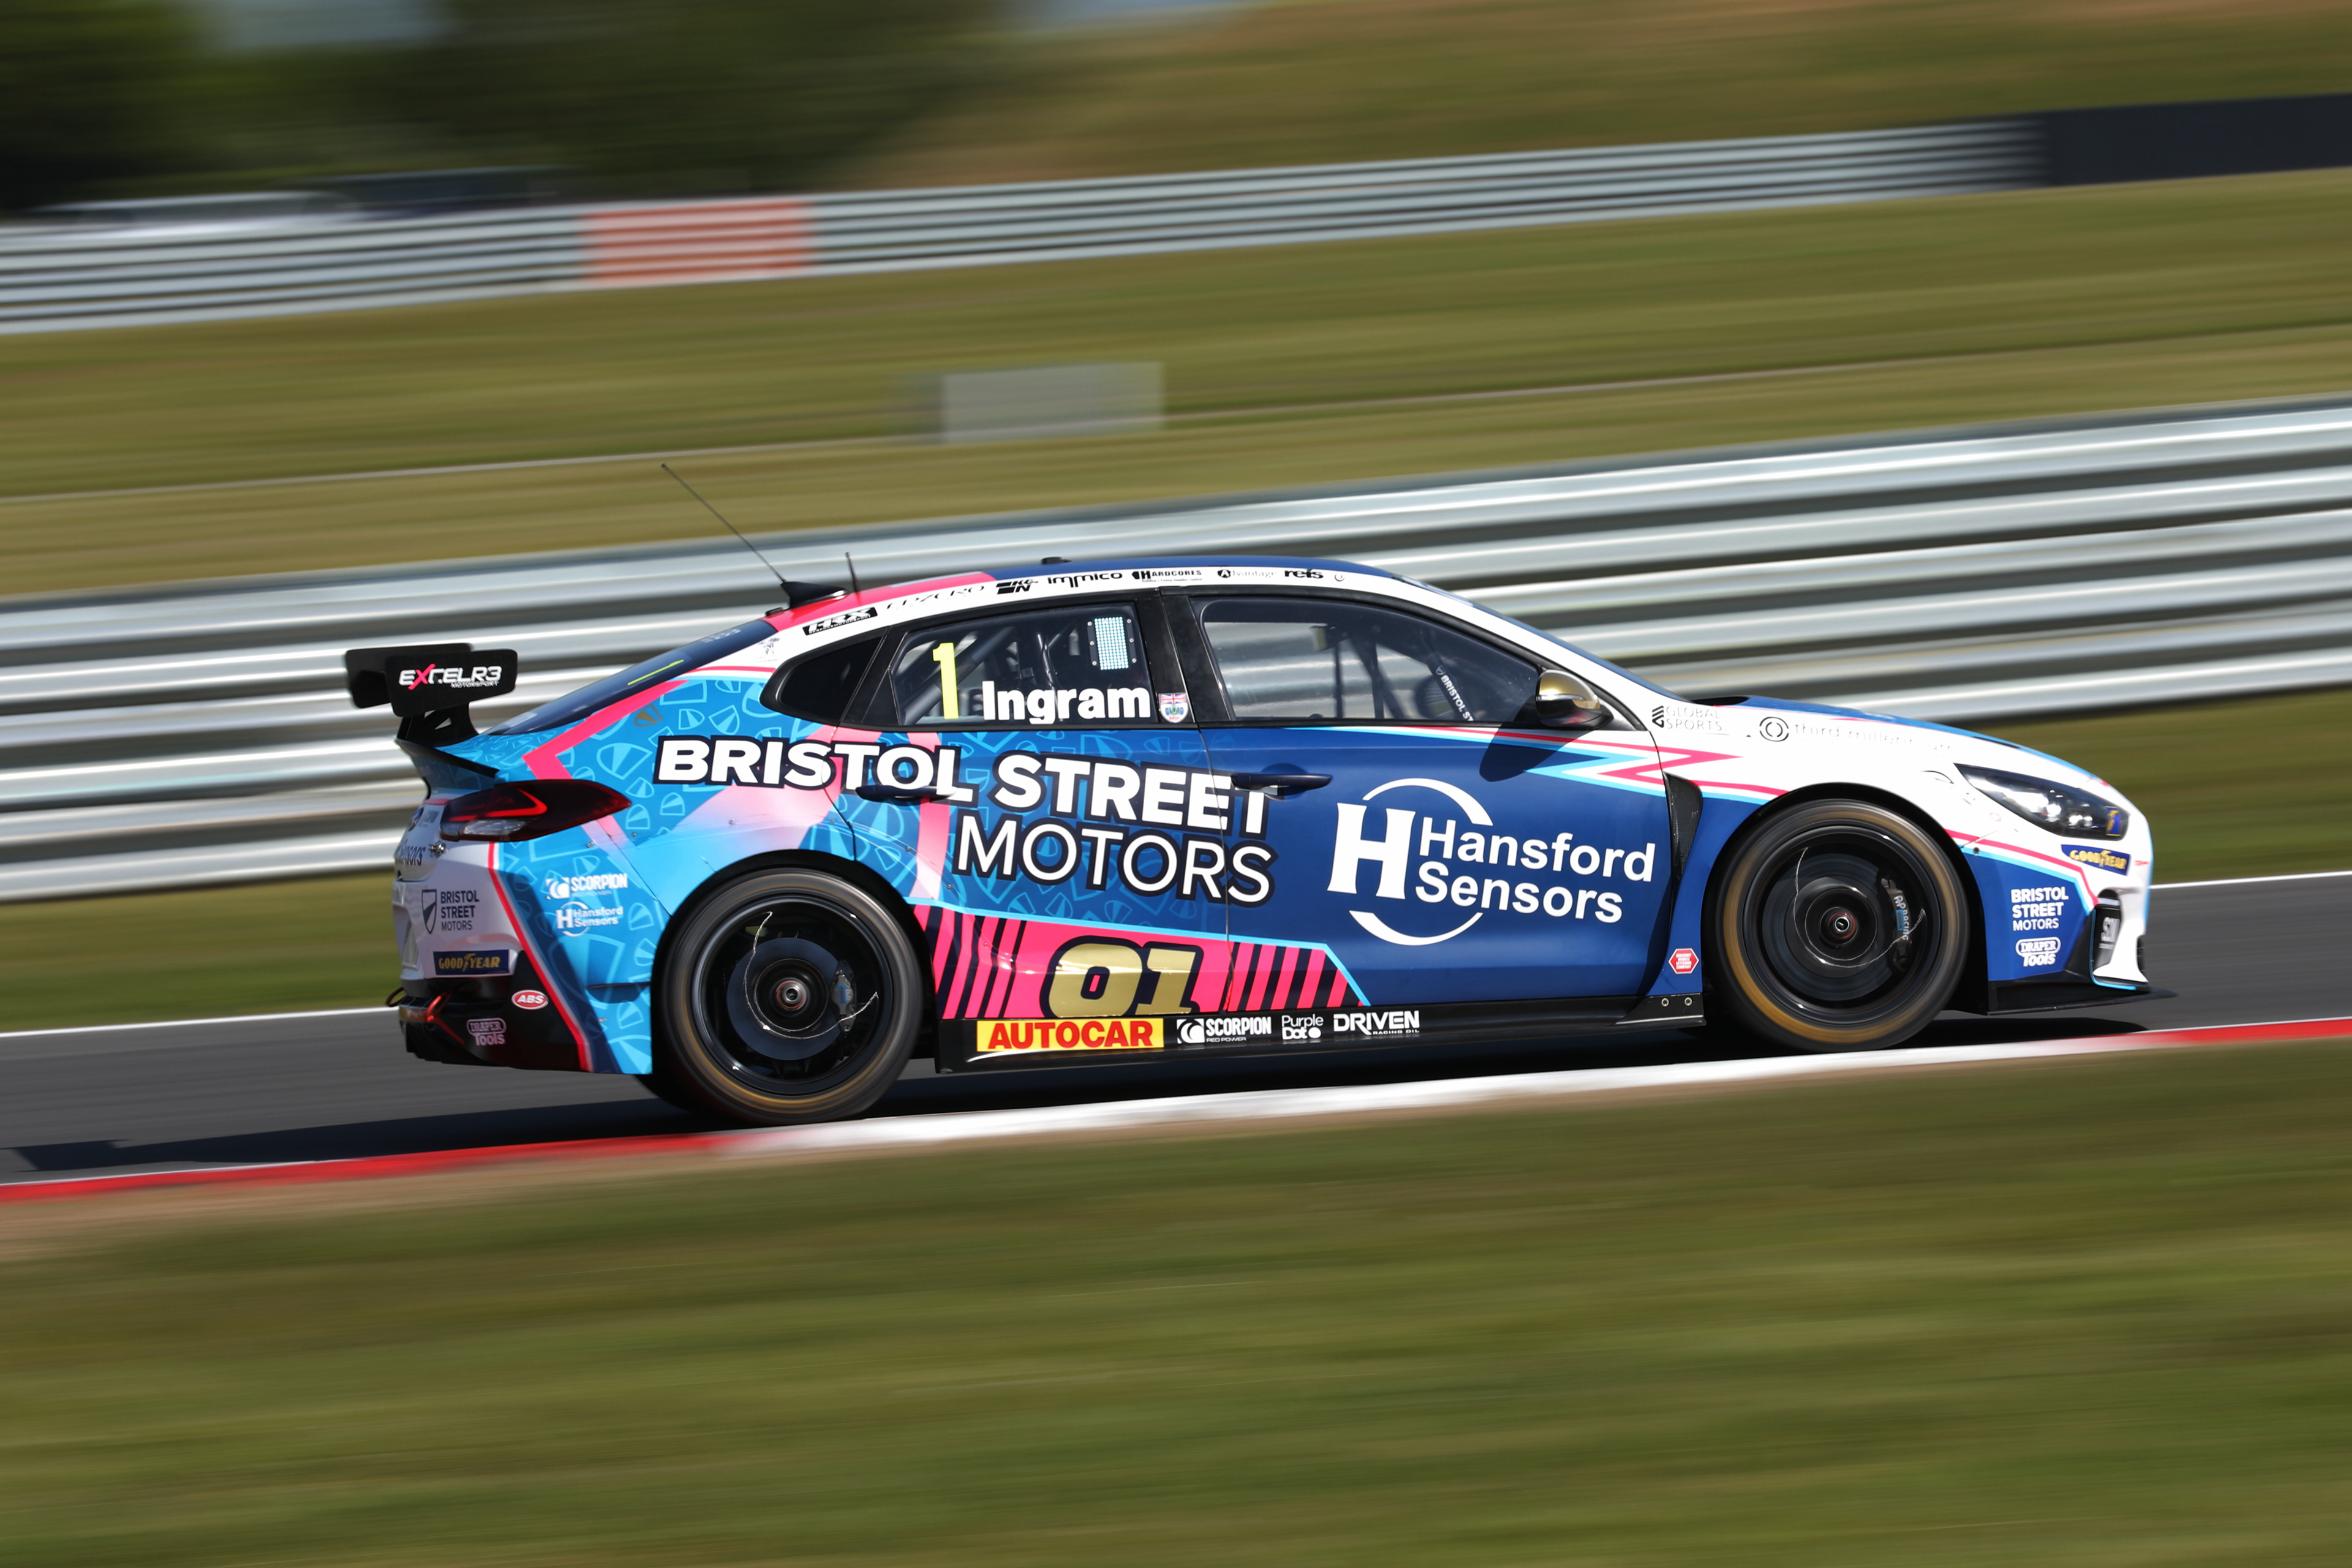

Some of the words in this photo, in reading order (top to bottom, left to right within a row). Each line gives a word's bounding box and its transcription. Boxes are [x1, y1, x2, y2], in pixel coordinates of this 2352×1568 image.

[1047, 572, 1123, 588] immico
[932, 643, 959, 720] 1
[1441, 674, 1466, 712] BRISTOL
[981, 680, 1152, 725] Ingram
[1666, 706, 1721, 720] GLOBAL
[657, 737, 974, 804] BRISTOL
[993, 753, 1278, 835] STREET
[1419, 816, 1656, 883] Hansford
[956, 814, 1272, 903] MOTORS
[570, 873, 628, 892] SCORPION
[440, 889, 480, 904] BRISTOL
[1415, 861, 1623, 923] Sensors
[2010, 886, 2069, 903] BRISTOL
[440, 905, 476, 919] STREET
[574, 906, 624, 918] Hansford
[2011, 902, 2064, 918] STREET
[441, 920, 472, 932] MOTORS
[573, 917, 619, 927] Sensors
[2013, 918, 2059, 931] MOTORS
[2020, 940, 2057, 953] DRAPER
[438, 953, 500, 972] GOODYEAR
[1045, 940, 1199, 1018] 01
[516, 993, 545, 1005] ABS
[470, 1021, 503, 1032] DRAPER
[1205, 1016, 1272, 1037] SCORPION
[1281, 1014, 1324, 1028] Purple
[1333, 1010, 1420, 1036] DRIVEN
[987, 1020, 1153, 1049] AUTOCAR
[1282, 1027, 1308, 1040] Dot
